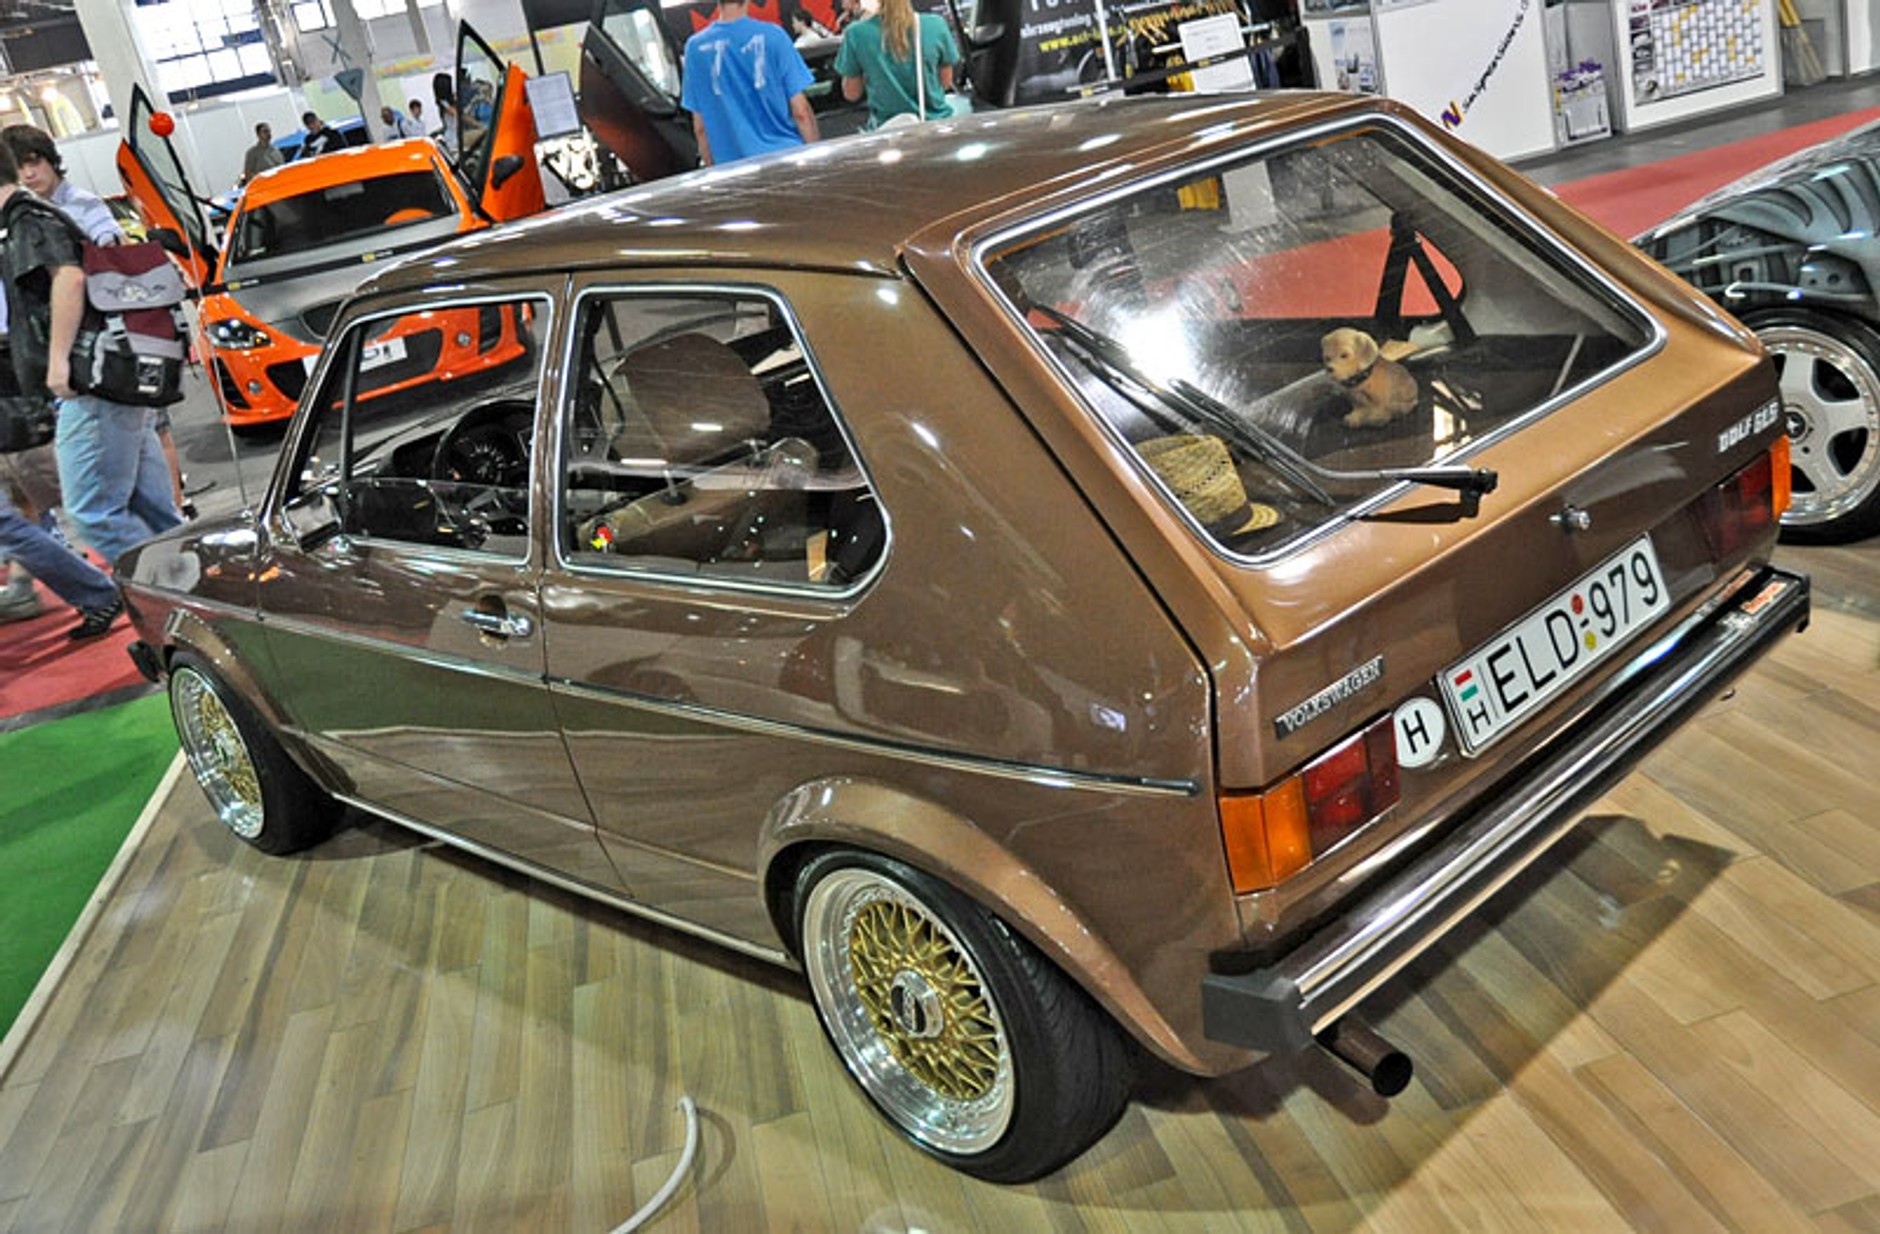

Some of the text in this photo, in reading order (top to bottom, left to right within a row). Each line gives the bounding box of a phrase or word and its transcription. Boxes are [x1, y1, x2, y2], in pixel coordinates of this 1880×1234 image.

[698, 34, 766, 95] 71
[1487, 551, 1659, 713] ELD-979
[1282, 658, 1381, 732] VOLKSWAGEN
[1467, 700, 1491, 734] H
[1402, 710, 1430, 754] H
